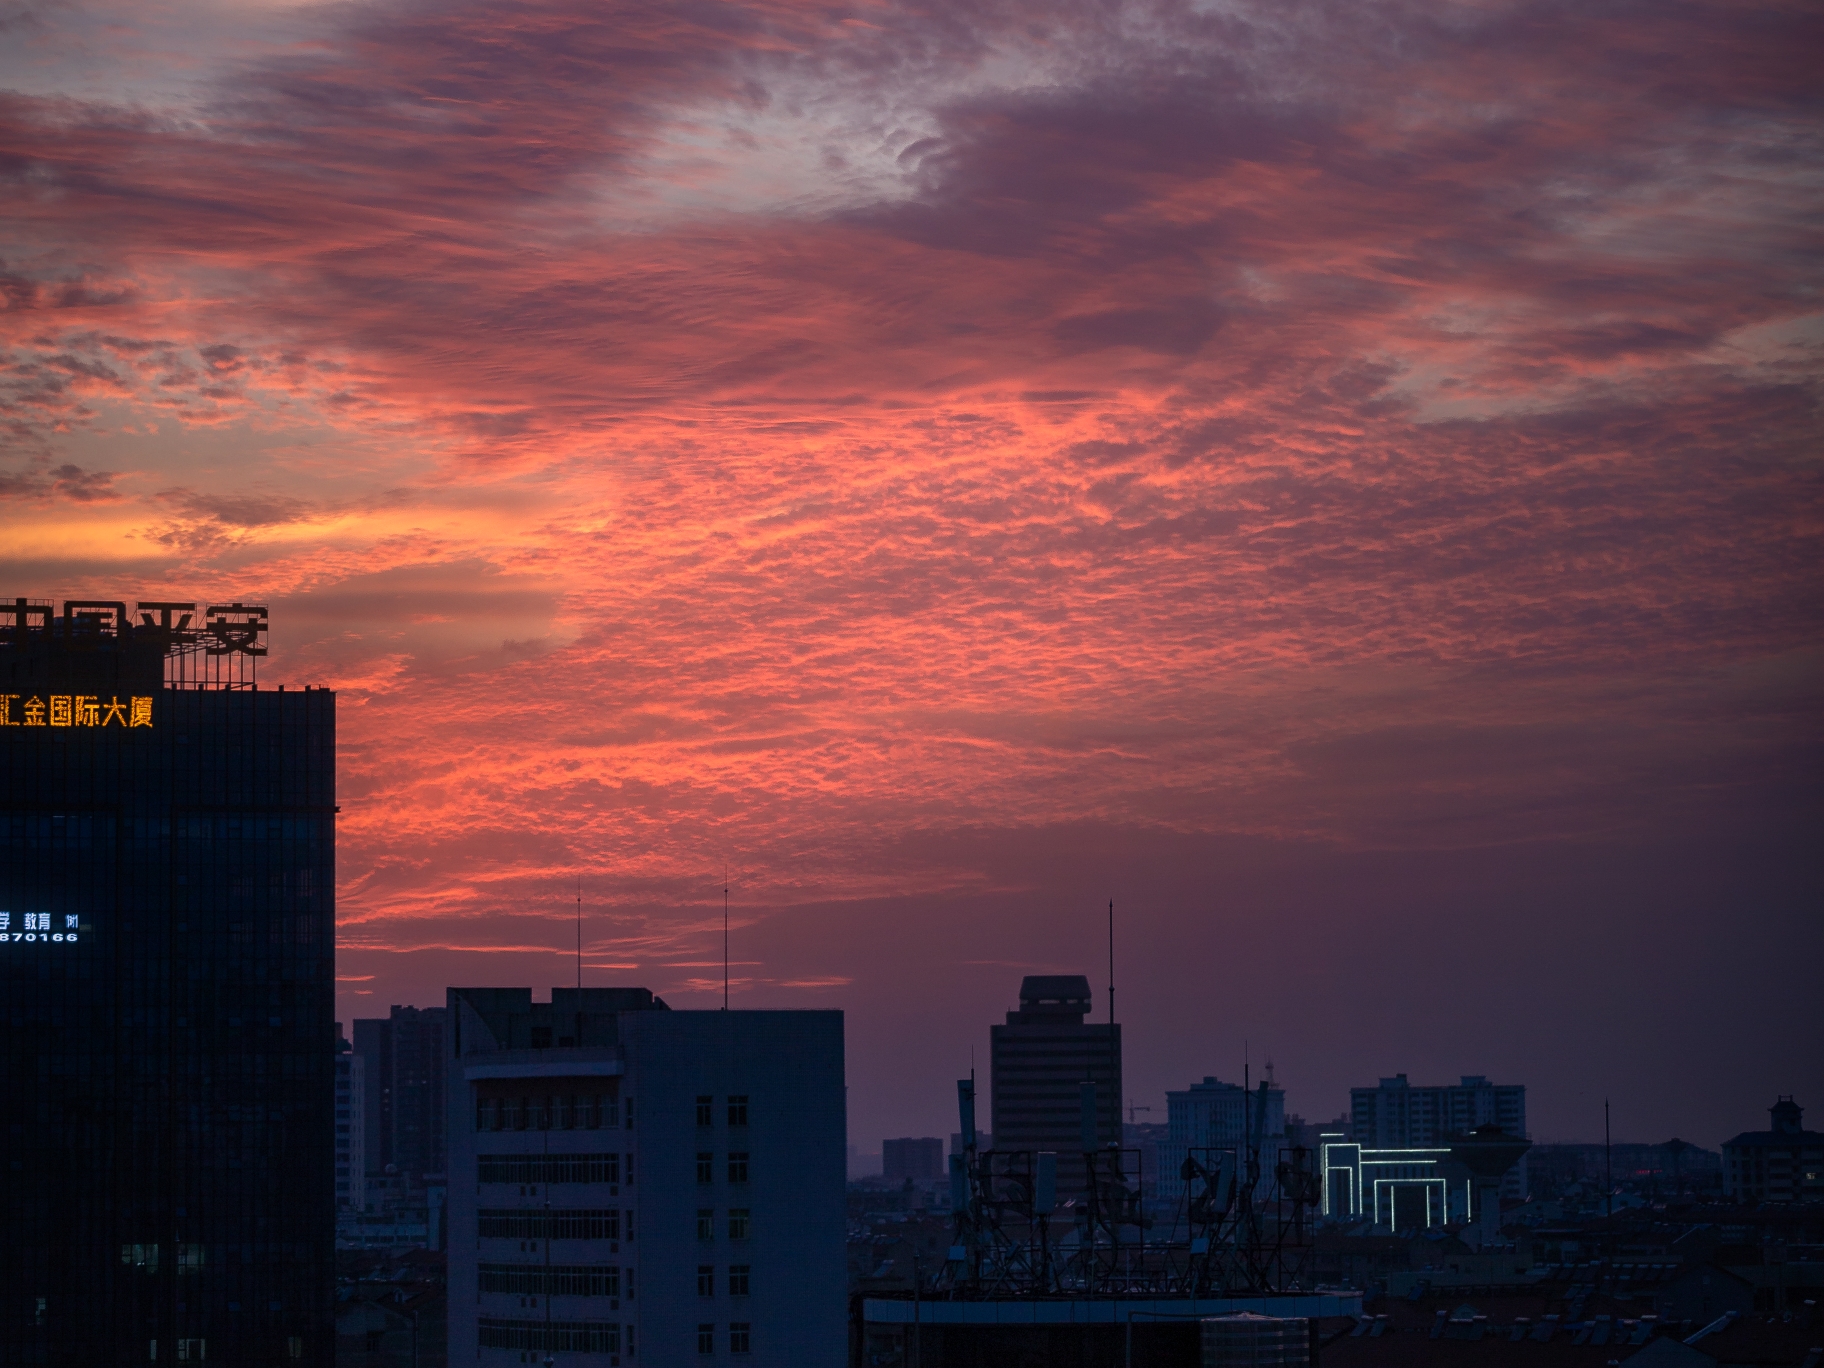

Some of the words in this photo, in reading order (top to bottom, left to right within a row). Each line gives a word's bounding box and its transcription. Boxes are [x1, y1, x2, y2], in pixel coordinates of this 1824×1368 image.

[0, 598, 268, 656] 中国平安
[0, 694, 153, 728] 汇金国际大厦
[24, 912, 51, 930] 教育
[0, 933, 78, 942] 870166
